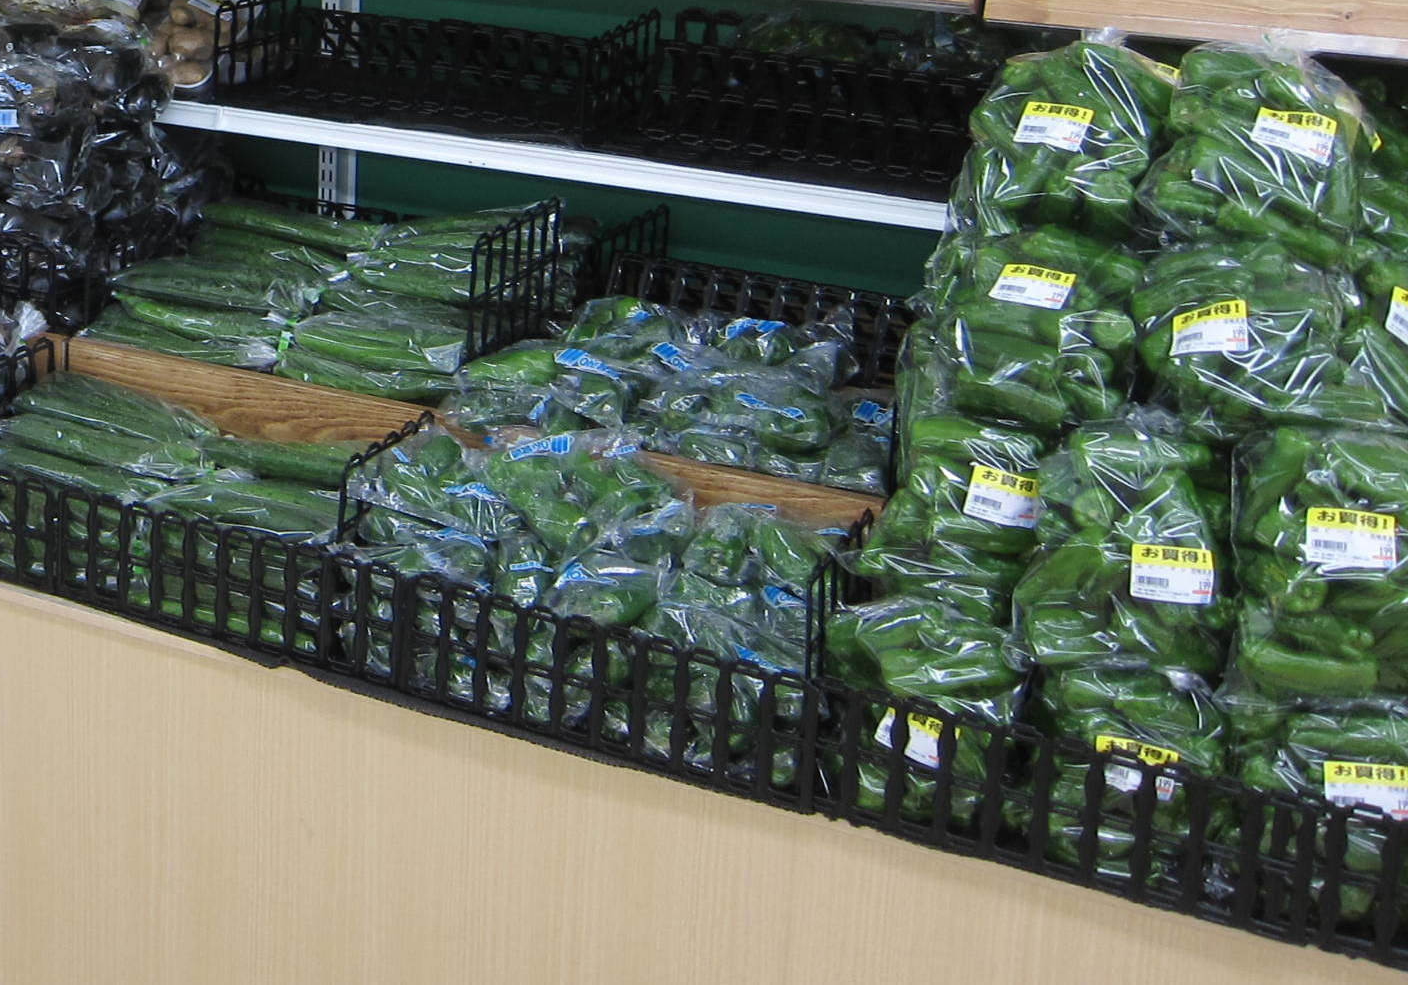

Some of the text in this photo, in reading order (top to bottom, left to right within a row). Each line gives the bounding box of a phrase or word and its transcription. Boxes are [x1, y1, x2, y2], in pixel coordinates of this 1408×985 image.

[1031, 103, 1088, 120] お買得!
[1008, 264, 1072, 285] お買得!
[1179, 303, 1243, 327] お買得!
[1314, 509, 1393, 530] お買得!
[1140, 546, 1210, 567] お買得!
